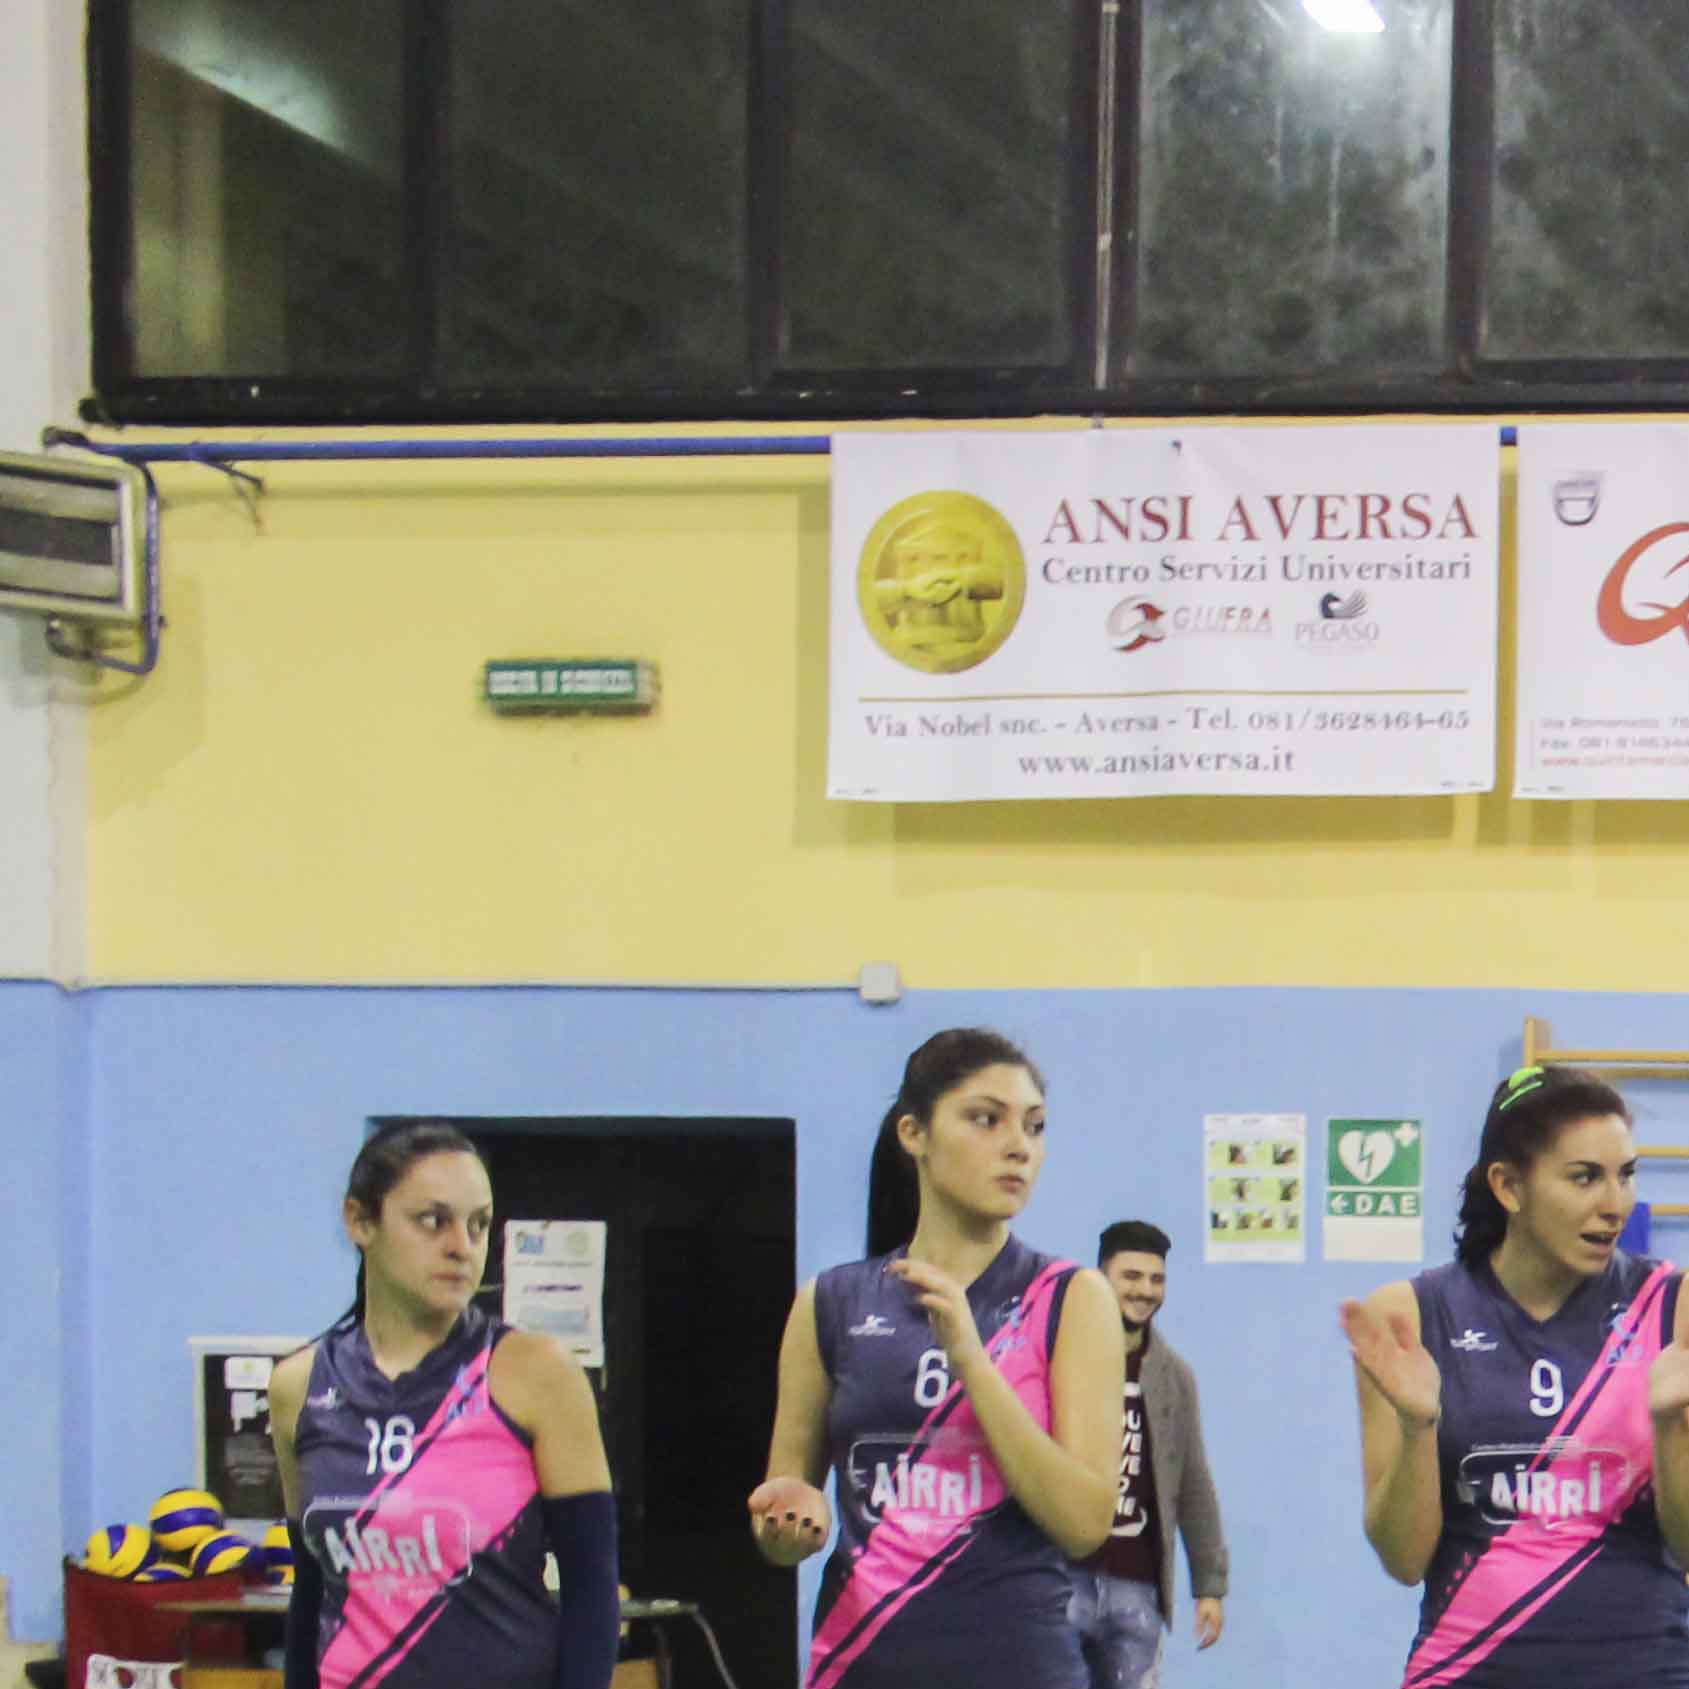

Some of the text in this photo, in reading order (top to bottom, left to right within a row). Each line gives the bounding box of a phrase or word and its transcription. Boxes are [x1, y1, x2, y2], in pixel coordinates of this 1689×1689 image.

[1042, 494, 1478, 544] ANSI AVERSA
[1041, 553, 1472, 585] Centro Servizi Universitari
[864, 715, 908, 738] Via
[918, 713, 992, 737] Nobel
[998, 716, 1048, 737] snc.
[1074, 711, 1159, 736] Aversa
[1186, 708, 1236, 732] Tel.
[1017, 747, 1296, 777] www.ansiaversa.it
[1354, 1192, 1418, 1215] DAE
[914, 1349, 950, 1408] 6
[1528, 1358, 1564, 1417] 9
[364, 1413, 416, 1476] 18
